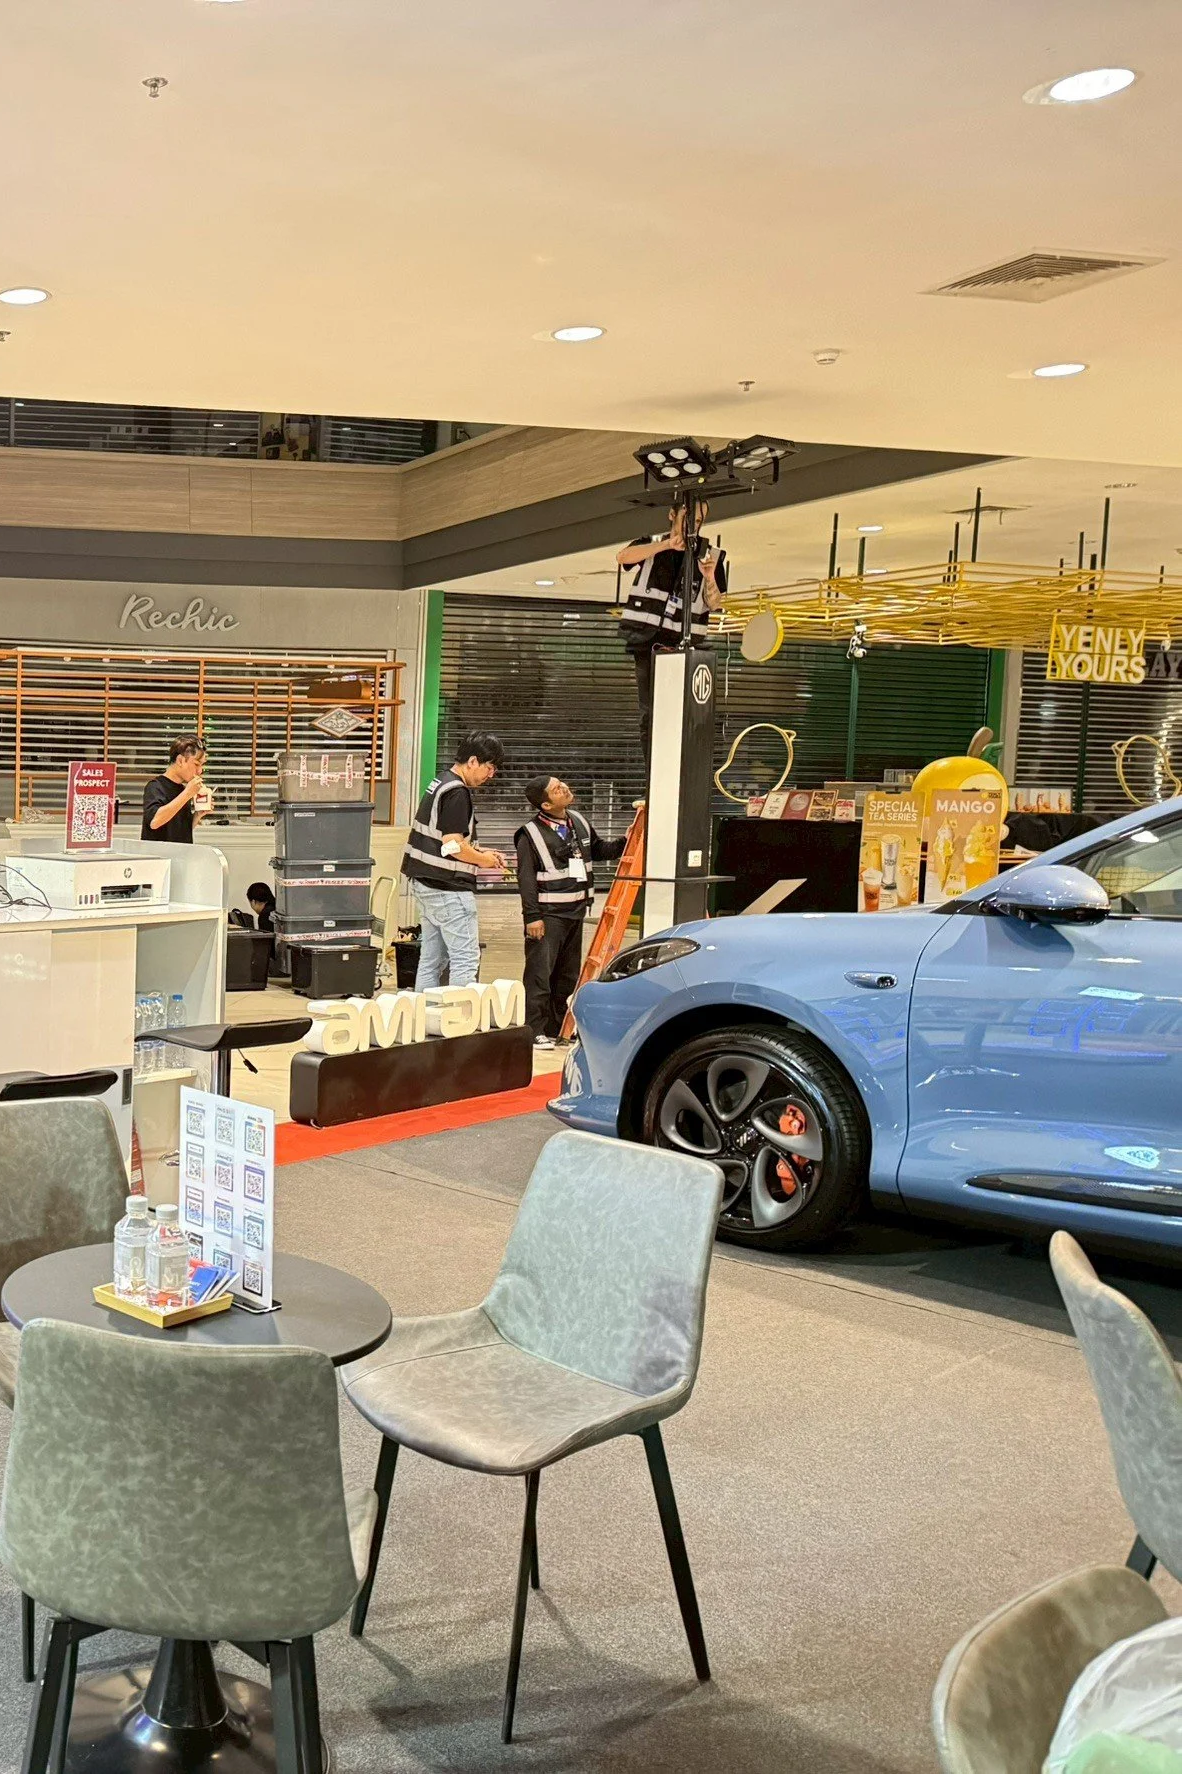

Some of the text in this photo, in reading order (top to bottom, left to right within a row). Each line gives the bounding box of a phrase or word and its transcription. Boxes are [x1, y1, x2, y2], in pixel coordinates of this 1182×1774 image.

[119, 593, 240, 633] Rechic
[1058, 653, 1147, 684] YOURS
[693, 667, 710, 701] MG
[81, 769, 104, 777] SALES
[74, 779, 110, 788] PROSPECT
[869, 800, 918, 813] SPECIAL
[936, 799, 996, 814] MANGO
[868, 812, 918, 822] TEA SERIES
